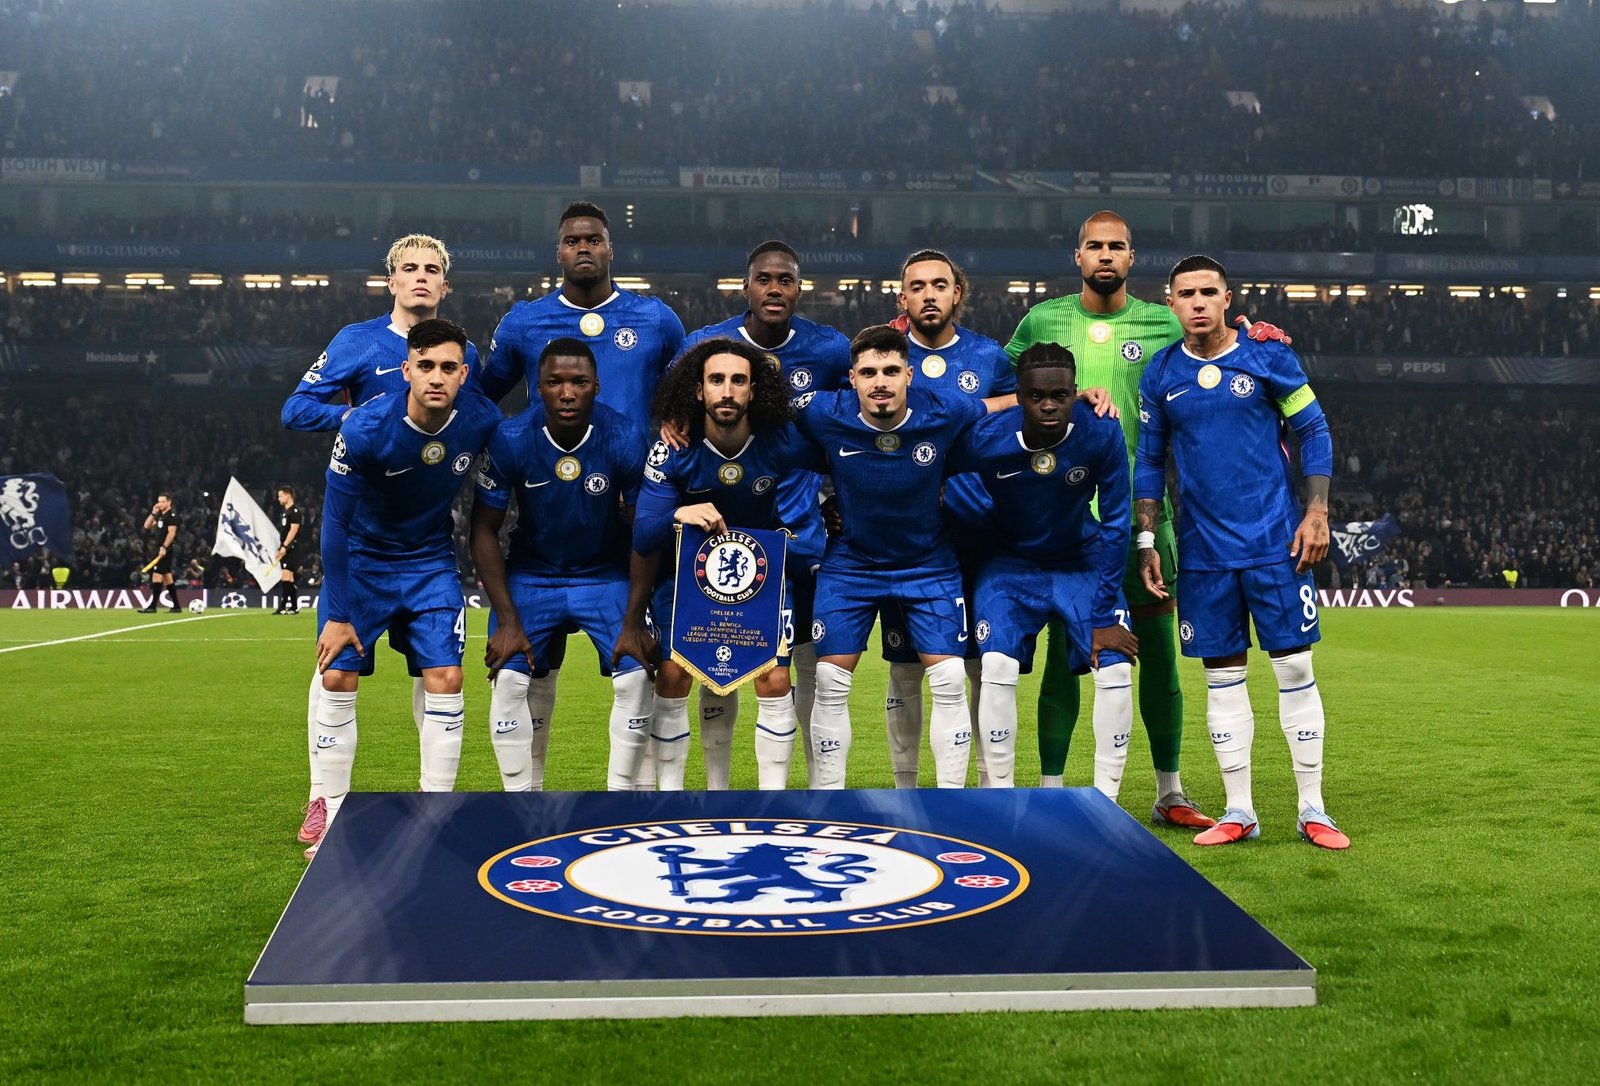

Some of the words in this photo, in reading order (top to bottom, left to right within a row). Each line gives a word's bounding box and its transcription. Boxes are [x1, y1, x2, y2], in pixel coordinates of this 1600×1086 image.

[3, 158, 57, 172] SOUTH
[64, 158, 107, 173] WEST
[707, 175, 760, 185] MALTA
[1194, 174, 1265, 183] MELBOURNE
[1194, 186, 1265, 195] CHELSEA
[56, 244, 103, 256] WORLD
[105, 244, 181, 257] CHAMPIONS
[1406, 258, 1441, 270] WORLD
[1442, 258, 1519, 270] CHAMPIONS
[86, 352, 138, 362] Heineken
[1403, 362, 1446, 373] PEPSI
[652, 472, 661, 480] 10
[709, 534, 757, 551] CHELSEA
[12, 590, 175, 609] AIRWAYS
[703, 586, 736, 602] FOOTBALL
[737, 588, 754, 600] CLUB
[1300, 584, 1316, 620] 8
[454, 606, 465, 642] 4
[578, 822, 898, 845] CHELSEA
[573, 905, 826, 928] FOOTBALL
[848, 901, 956, 923] CLUB
